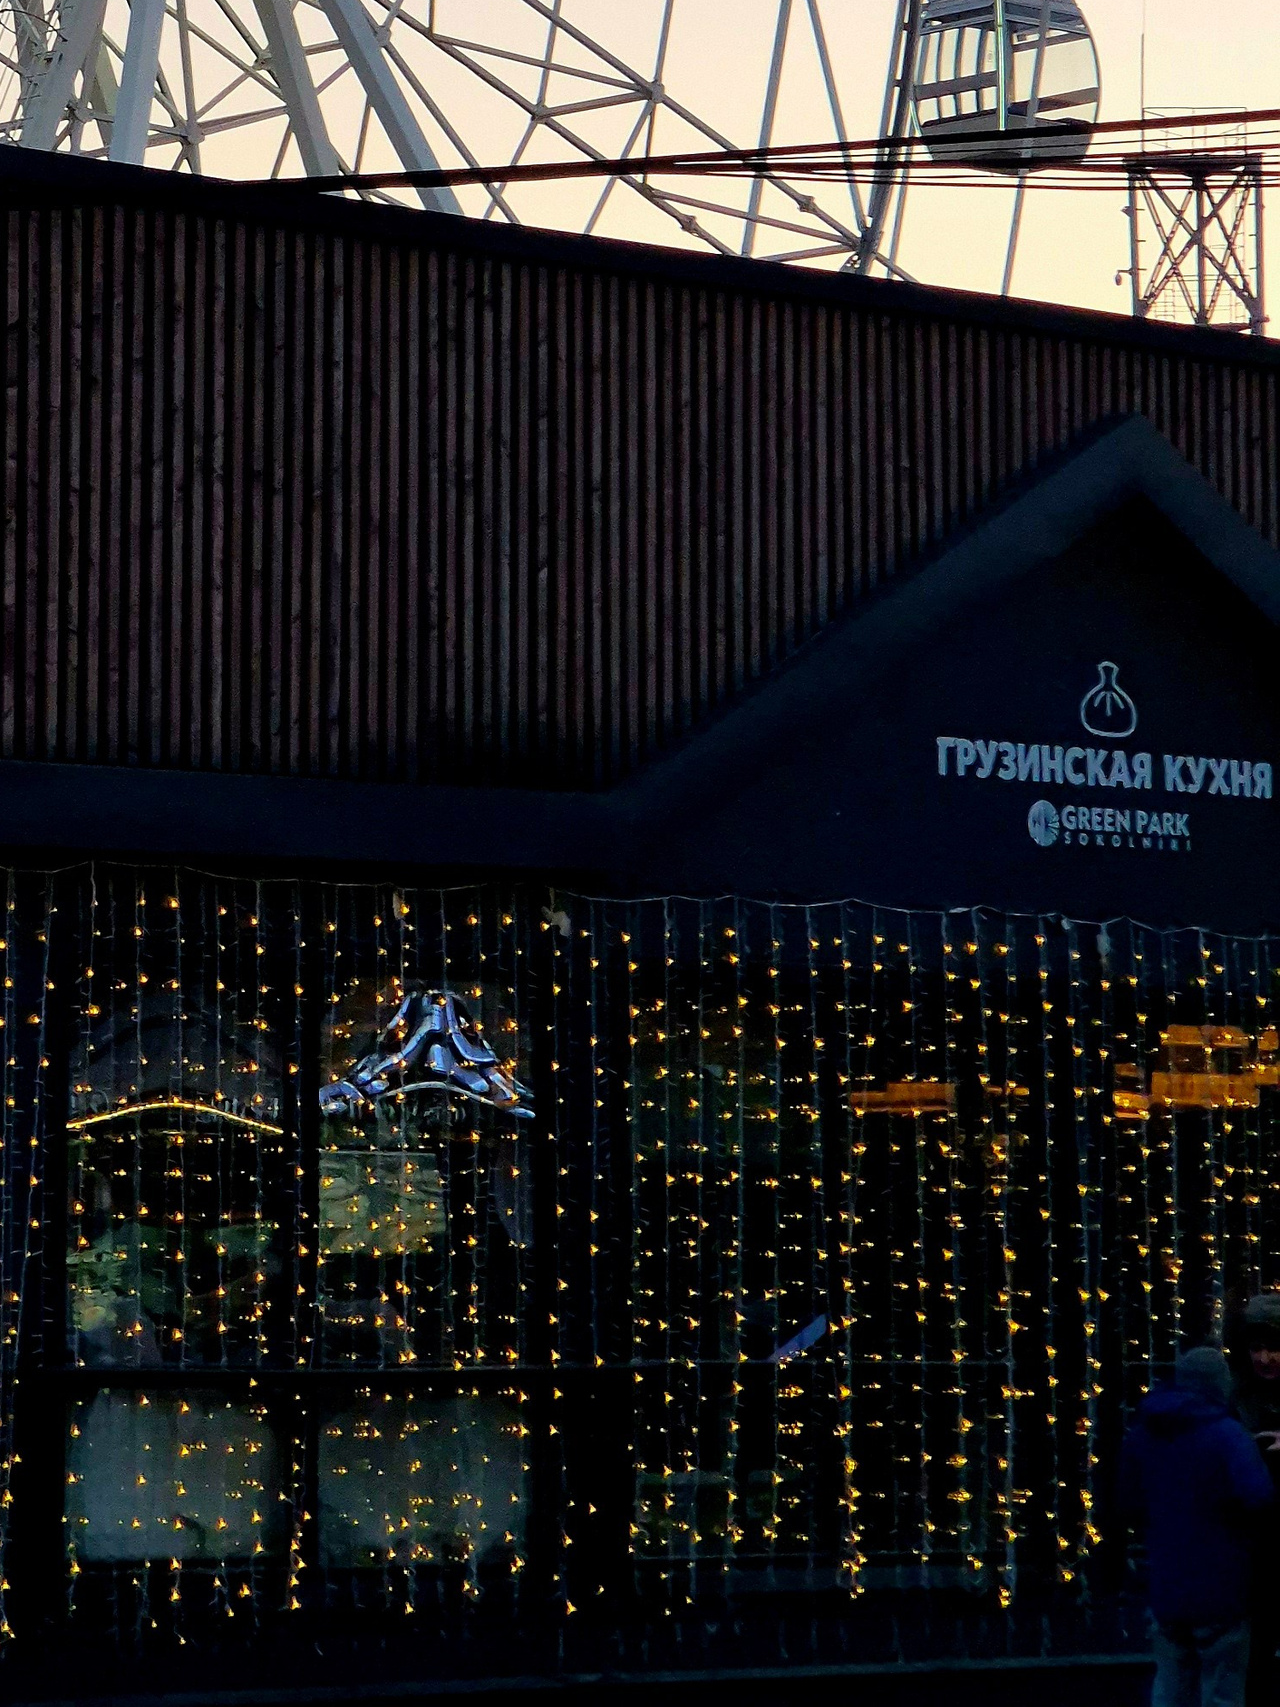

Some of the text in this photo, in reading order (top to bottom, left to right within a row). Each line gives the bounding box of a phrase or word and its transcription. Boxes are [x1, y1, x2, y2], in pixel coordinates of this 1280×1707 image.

[936, 736, 1273, 799] ГРУЗИНСКАЯ КУХНЯ
[1061, 805, 1190, 837] GREEN PARK
